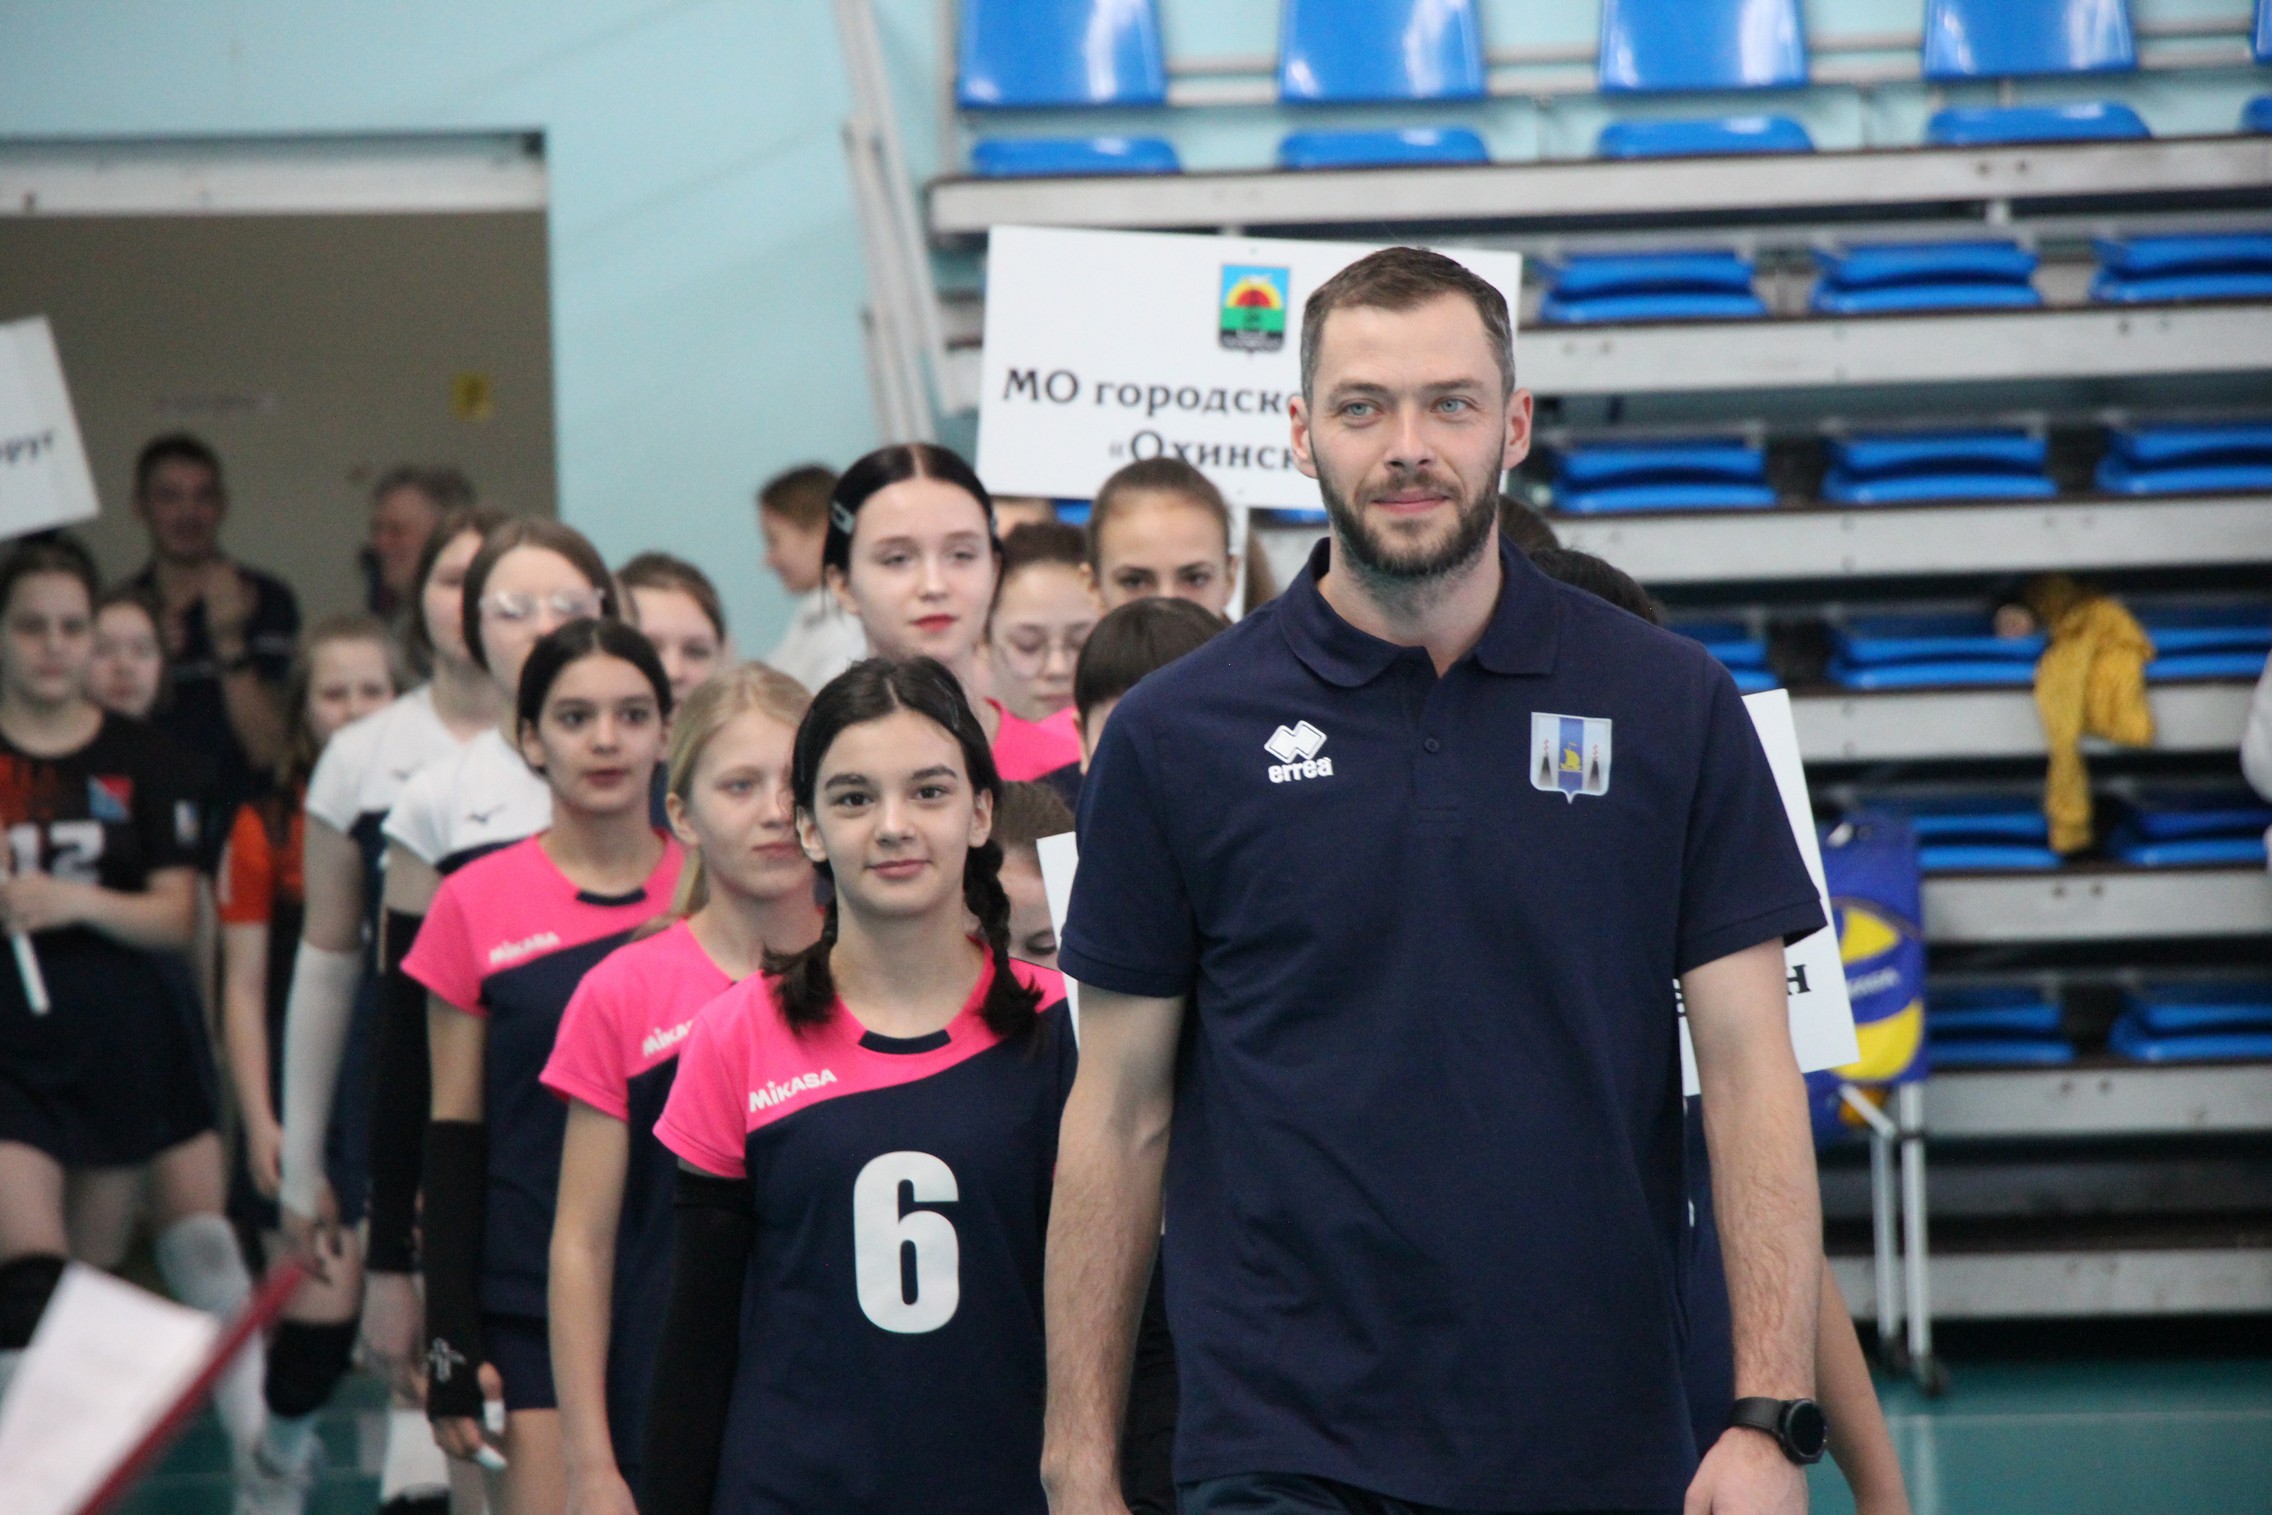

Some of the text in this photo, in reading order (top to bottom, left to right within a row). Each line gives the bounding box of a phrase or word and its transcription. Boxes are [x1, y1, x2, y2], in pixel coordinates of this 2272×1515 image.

[1003, 367, 1291, 418] МО городск
[853, 1150, 960, 1334] 6
